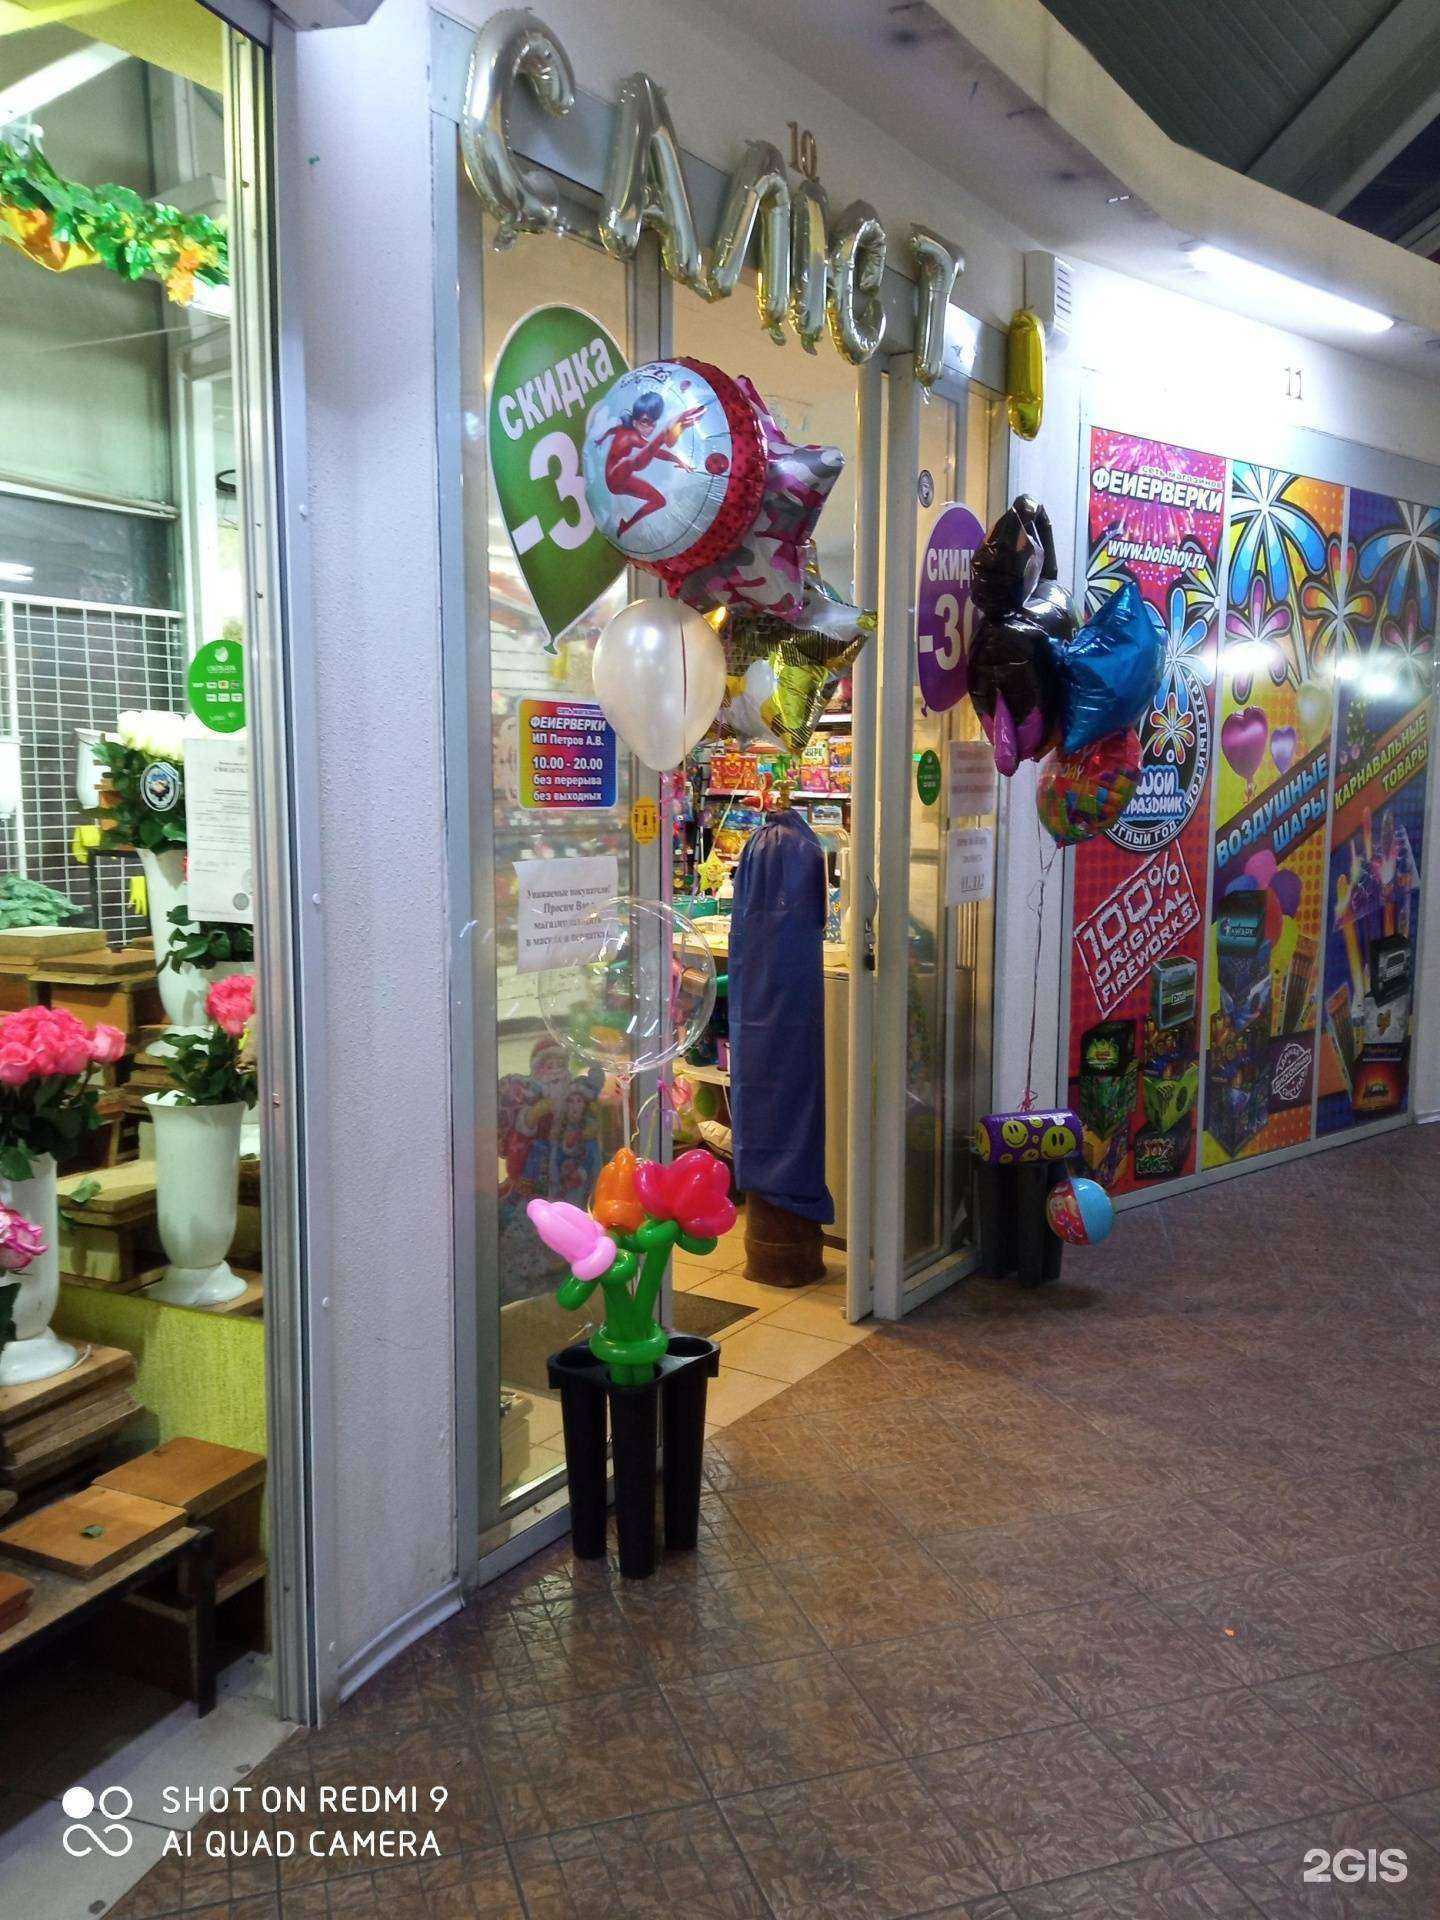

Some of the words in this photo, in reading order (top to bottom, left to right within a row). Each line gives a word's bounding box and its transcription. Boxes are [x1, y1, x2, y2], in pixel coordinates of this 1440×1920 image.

[1107, 540, 1208, 571] www.bolshoy.ru
[532, 733, 547, 744] ИП
[550, 733, 584, 746] Петров
[586, 736, 604, 746] А.В.
[533, 757, 564, 769] 10.00
[573, 757, 603, 770] 20.00
[1334, 714, 1426, 810] КАРНАВАЛЬНЫЕ
[1383, 740, 1428, 793] ТОВАРЫ
[533, 774, 552, 785] без
[554, 776, 602, 787] перерыва
[533, 791, 552, 801] без
[554, 792, 602, 802] выходных
[1216, 752, 1329, 868] ВОЗДУШНЫЕ
[1273, 788, 1327, 853] ШАРЫ
[1083, 851, 1181, 960] 100%
[1095, 890, 1190, 986] ORIGINAL
[1102, 903, 1194, 1004] FIREWORKS
